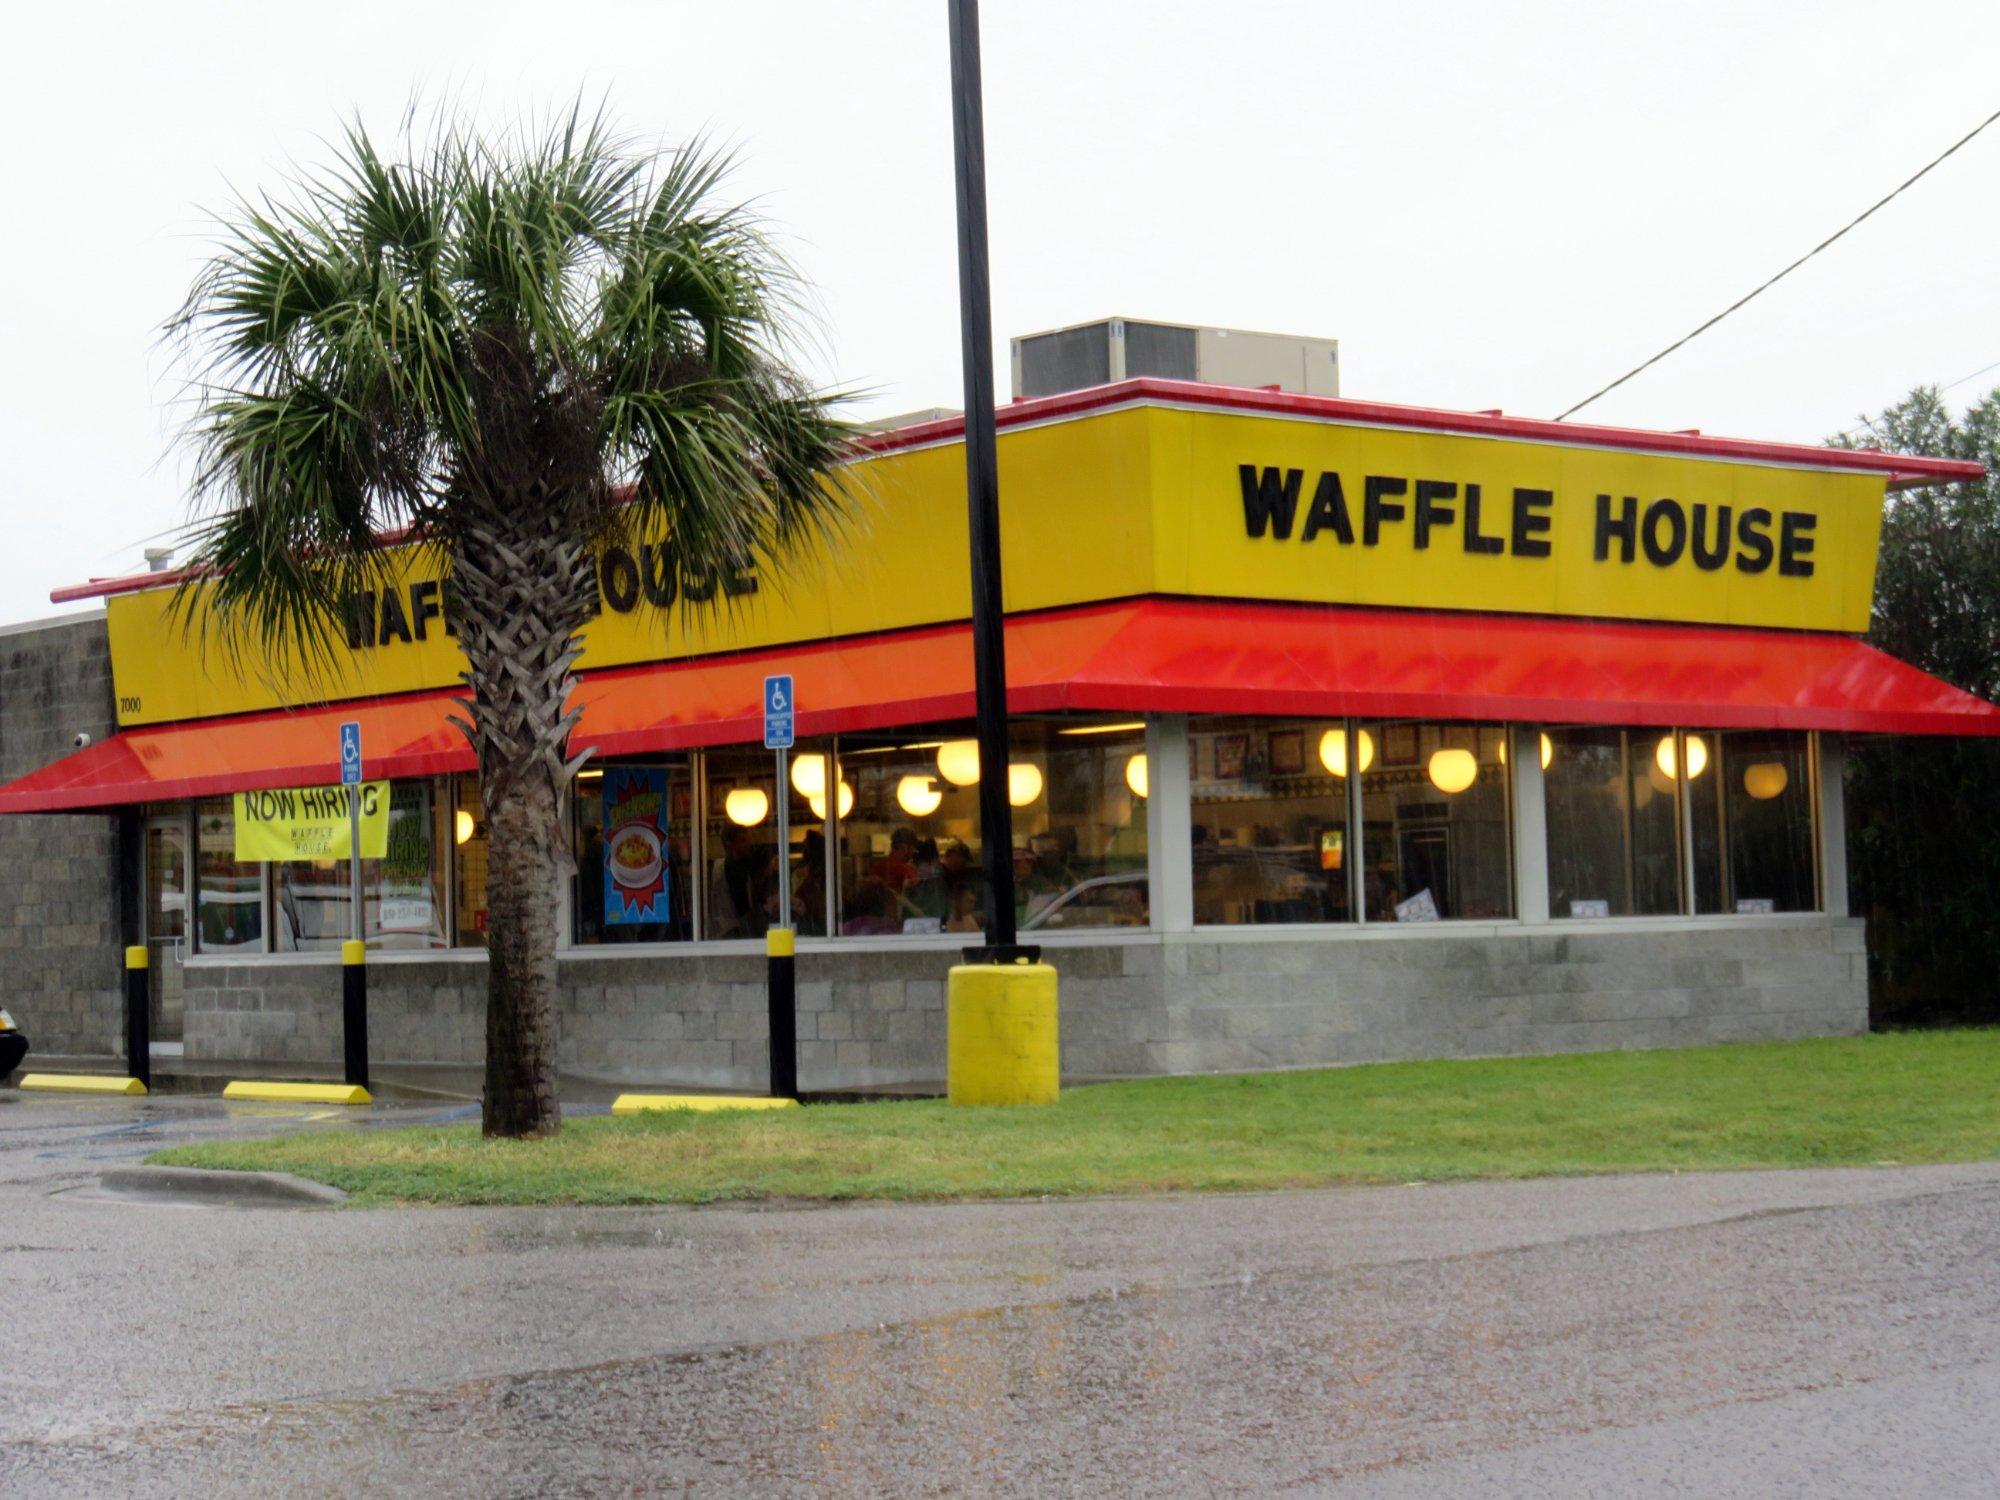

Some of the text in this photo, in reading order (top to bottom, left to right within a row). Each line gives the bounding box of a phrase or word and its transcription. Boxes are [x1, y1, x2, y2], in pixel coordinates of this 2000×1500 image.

[1237, 463, 1818, 578] WAFFLE HOUSE
[346, 540, 758, 651] WAF OUSE
[120, 697, 141, 712] 7000
[243, 790, 296, 822] NOW
